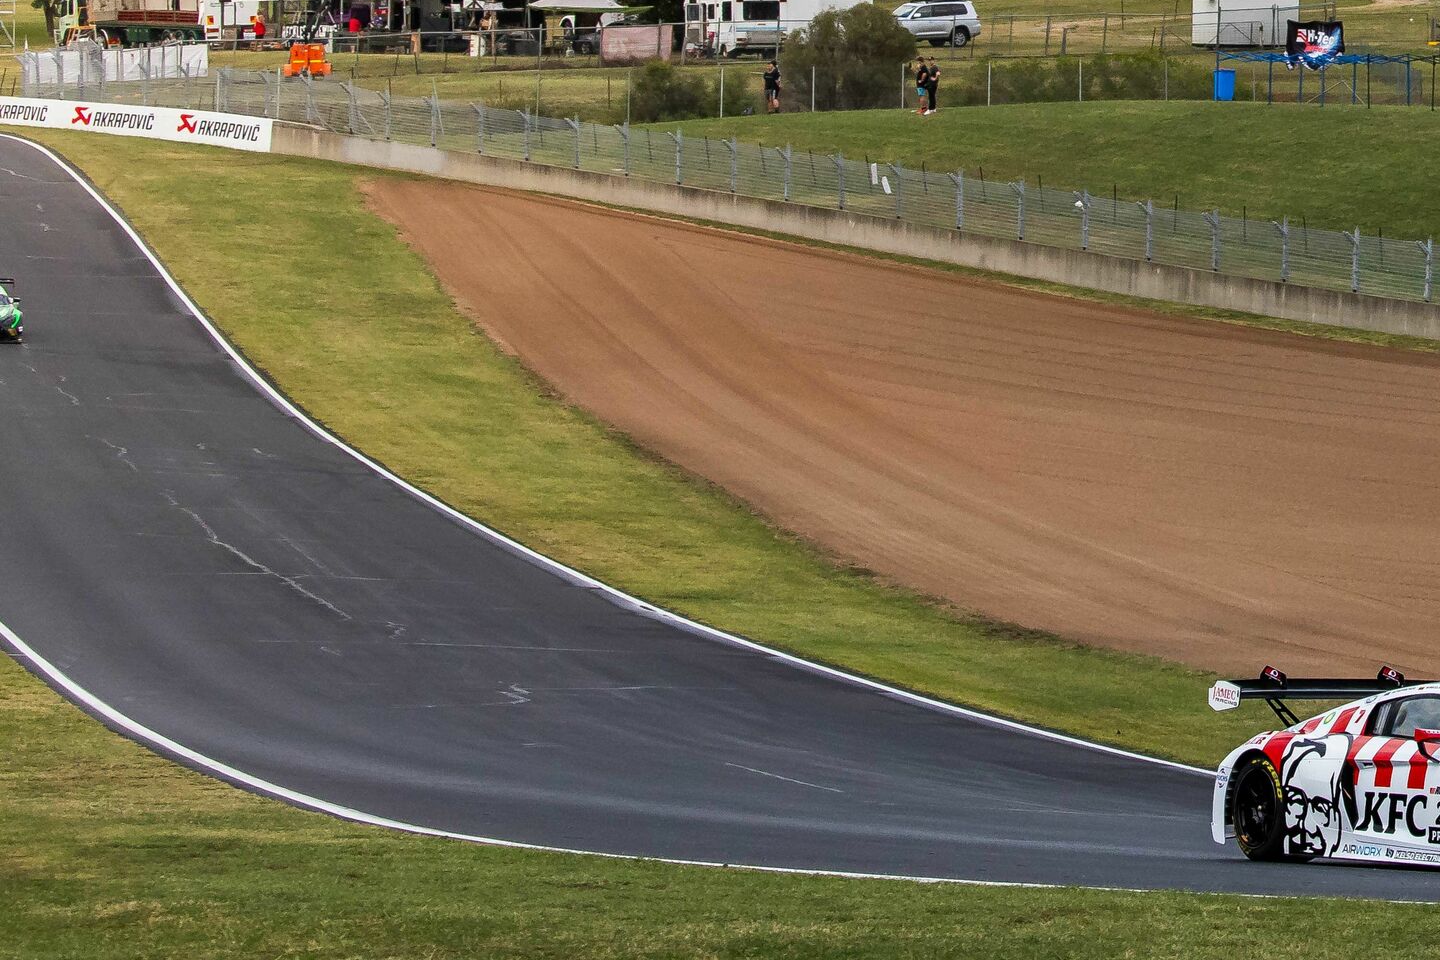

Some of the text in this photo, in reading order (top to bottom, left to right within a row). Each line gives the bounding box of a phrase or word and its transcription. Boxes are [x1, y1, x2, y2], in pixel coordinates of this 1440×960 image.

[0, 104, 48, 122] KRAPOVIČ
[1355, 791, 1428, 837] KFC
[1342, 843, 1382, 857] AIRWORX
